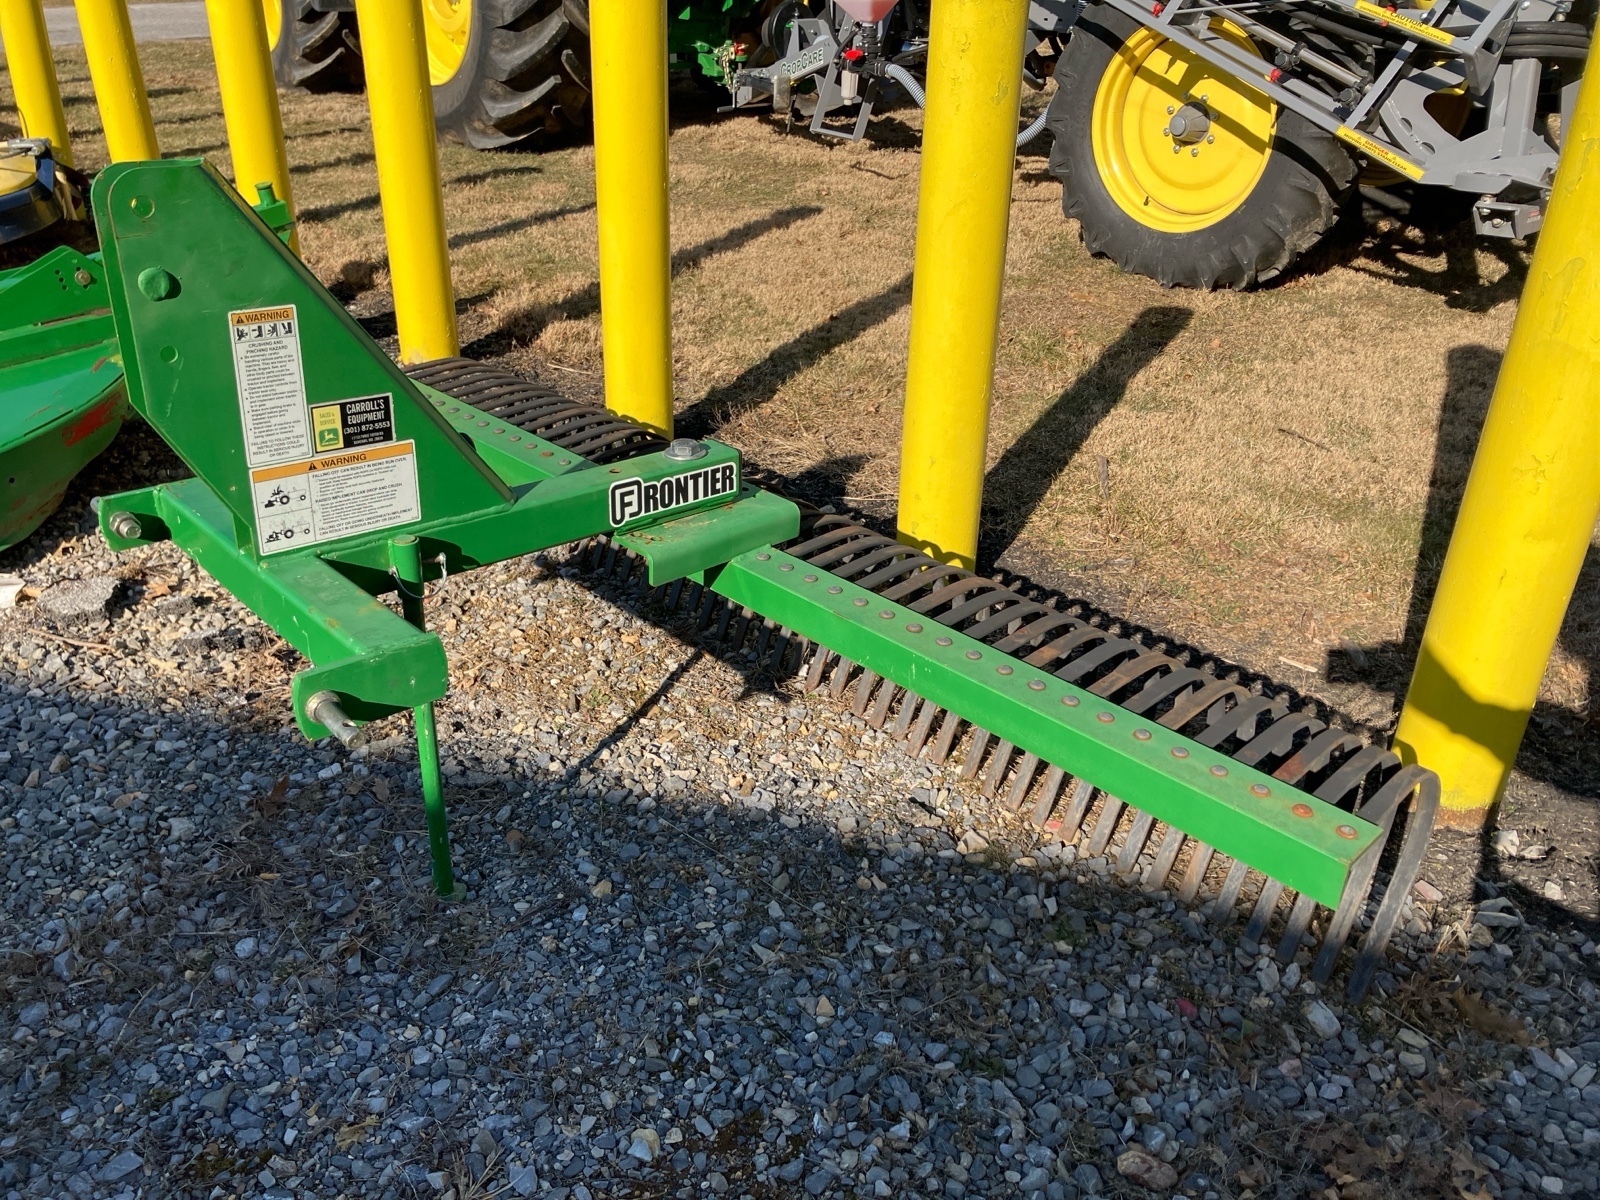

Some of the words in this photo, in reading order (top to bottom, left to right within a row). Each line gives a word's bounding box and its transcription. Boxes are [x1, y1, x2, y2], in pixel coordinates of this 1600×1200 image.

[245, 310, 289, 322] WARNING
[346, 399, 385, 414] CARROLL'S
[347, 410, 385, 425] EQUIPMENT
[344, 425, 360, 435] (301)
[361, 421, 391, 432] 872-5553
[321, 453, 367, 468] WARNING
[610, 464, 736, 526] FRONTIER
